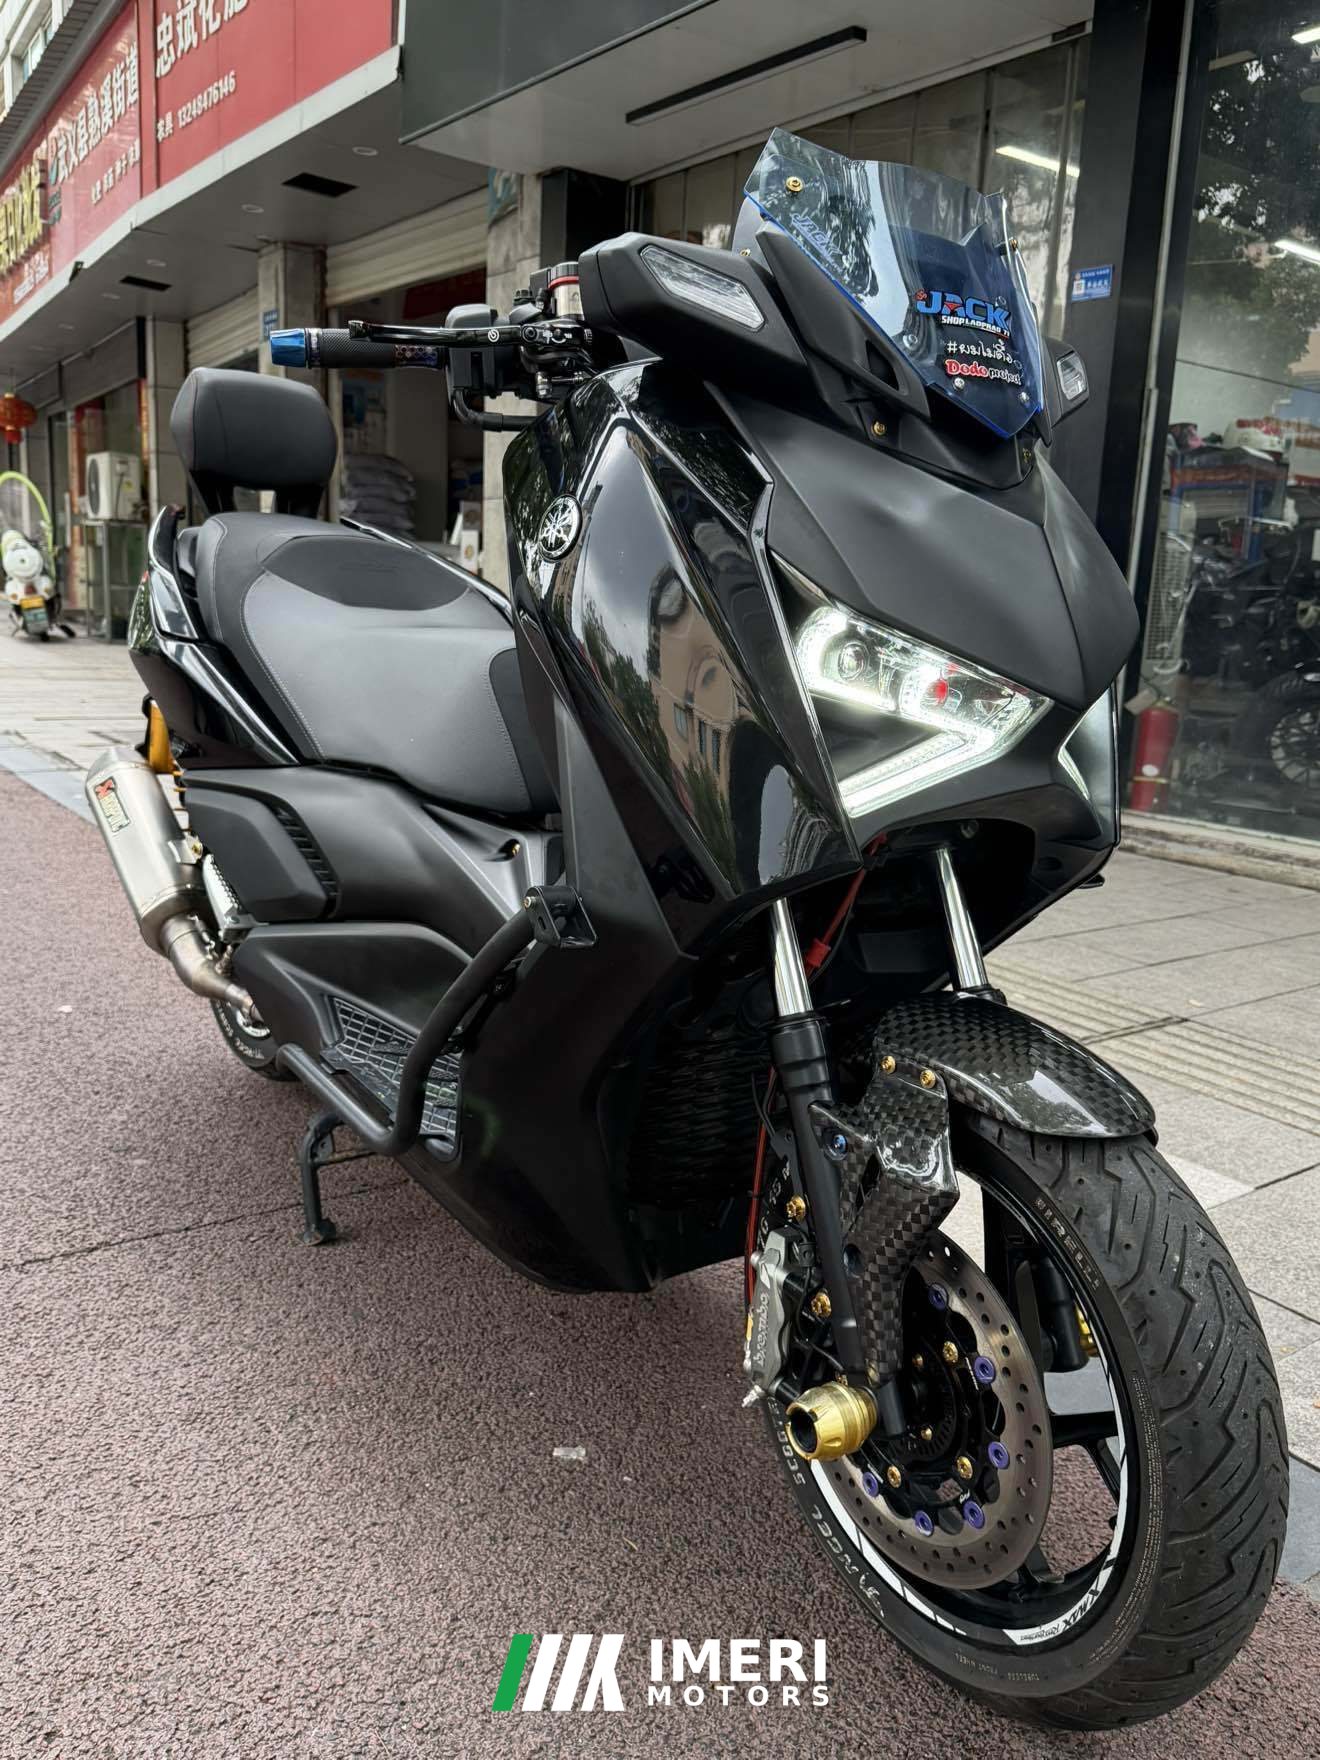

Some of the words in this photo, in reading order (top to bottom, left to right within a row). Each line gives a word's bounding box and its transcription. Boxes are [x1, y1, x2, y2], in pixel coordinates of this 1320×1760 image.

[156, 0, 247, 78] 忠斌化
[178, 70, 236, 128] 13248476146
[916, 289, 1011, 331] JACK
[941, 315, 965, 326] SHOP
[945, 359, 989, 378] Dodo
[753, 1292, 770, 1368] brembo
